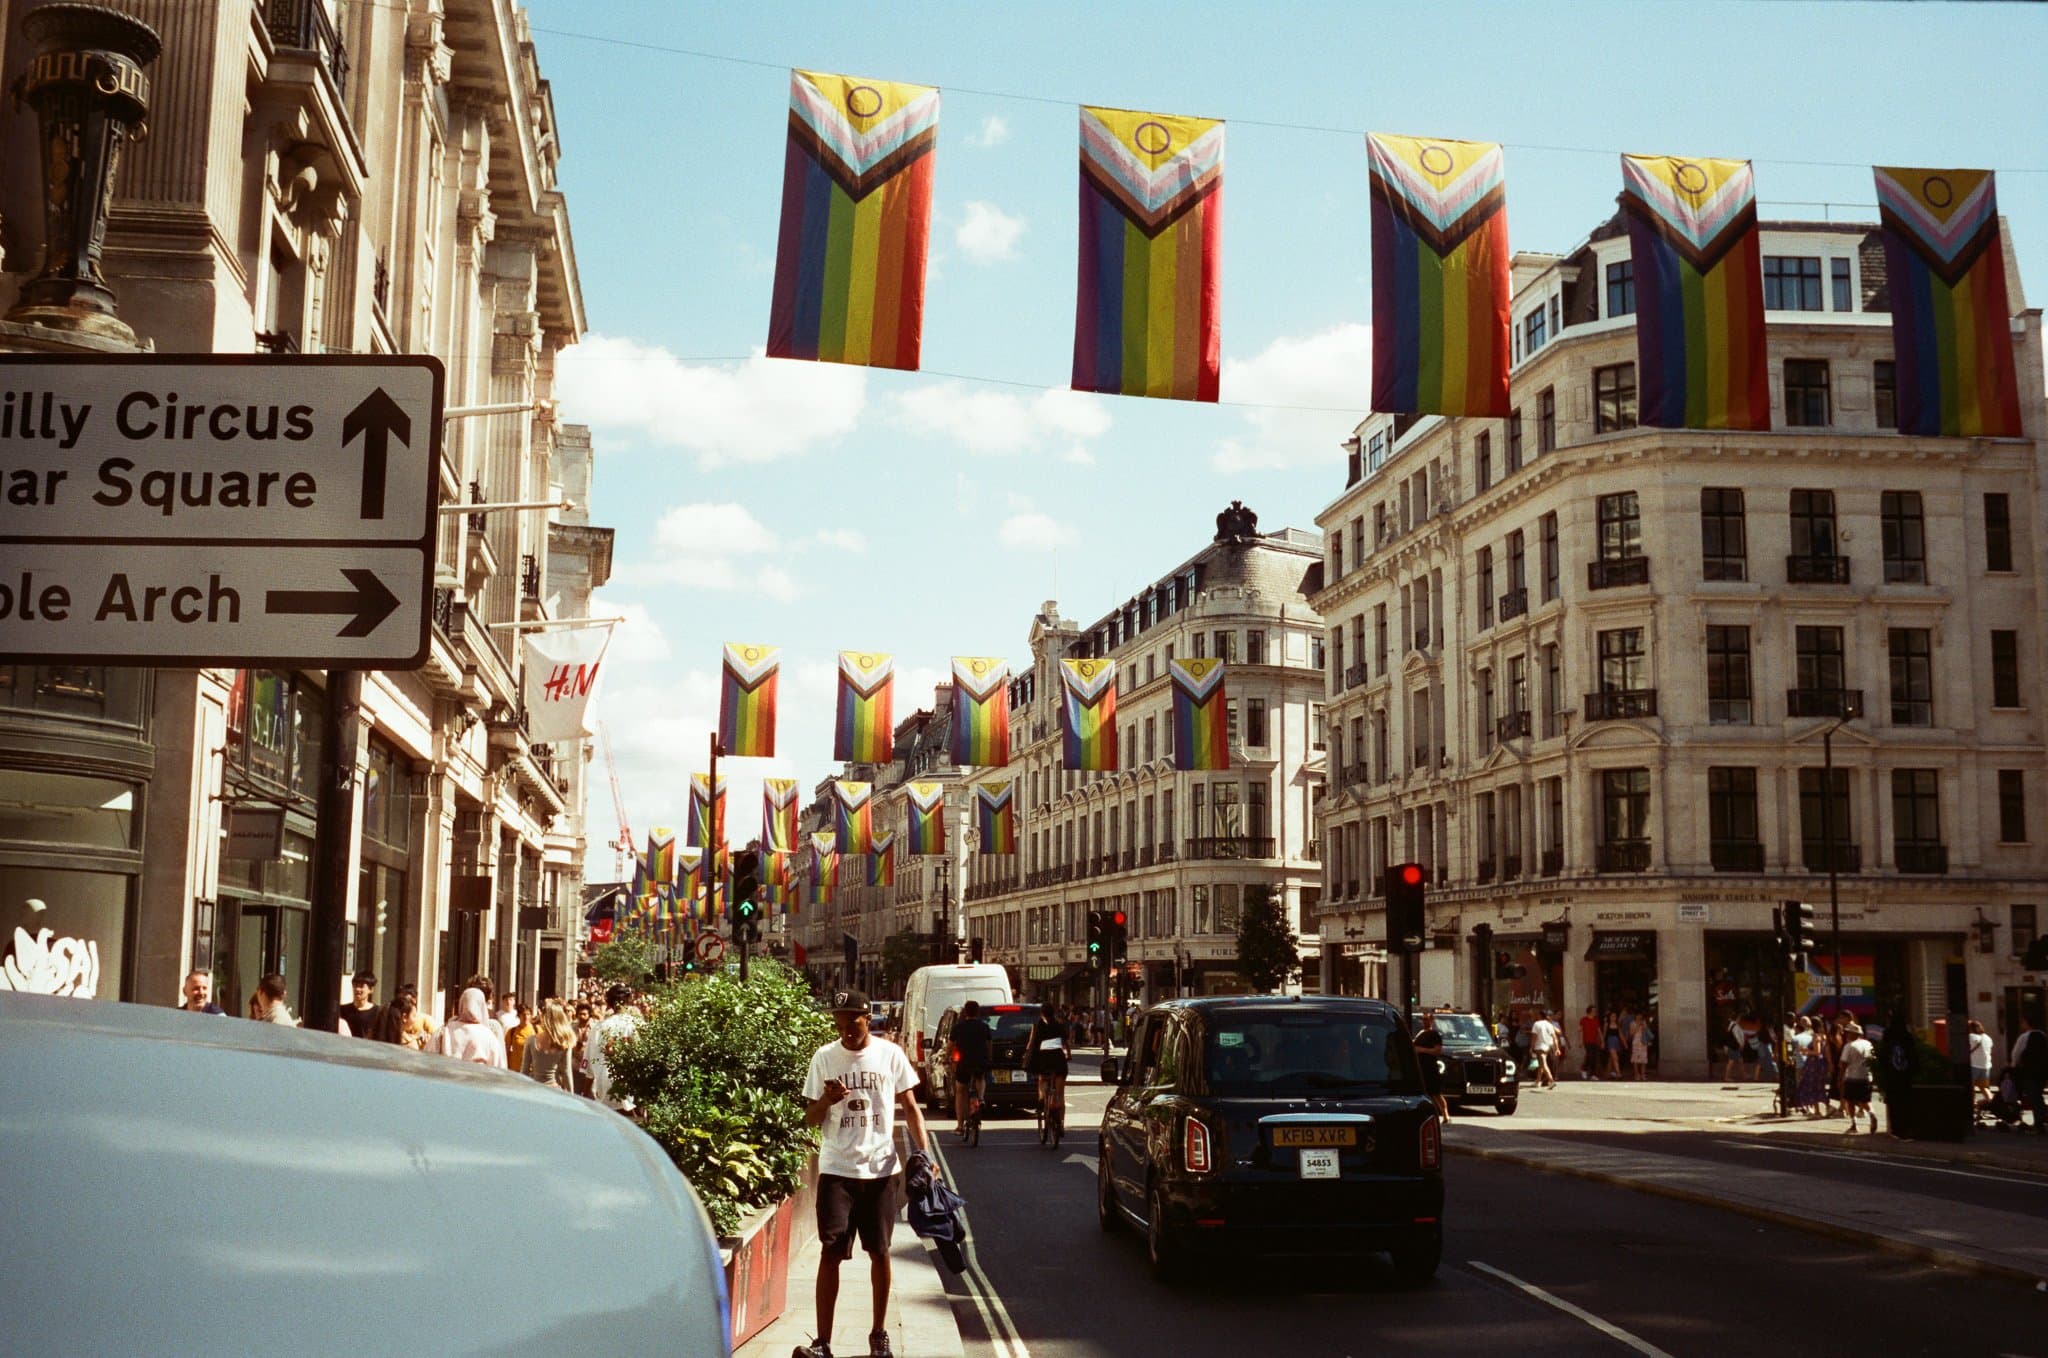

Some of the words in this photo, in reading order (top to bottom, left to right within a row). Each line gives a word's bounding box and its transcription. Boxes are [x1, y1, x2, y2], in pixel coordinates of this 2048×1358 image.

[115, 390, 315, 441] Circus
[92, 456, 318, 516] Square
[94, 573, 242, 624] Arch
[543, 662, 600, 703] H&M
[840, 1116, 855, 1129] ART
[1282, 1128, 1314, 1143] KF19
[1319, 1128, 1347, 1143] XVR
